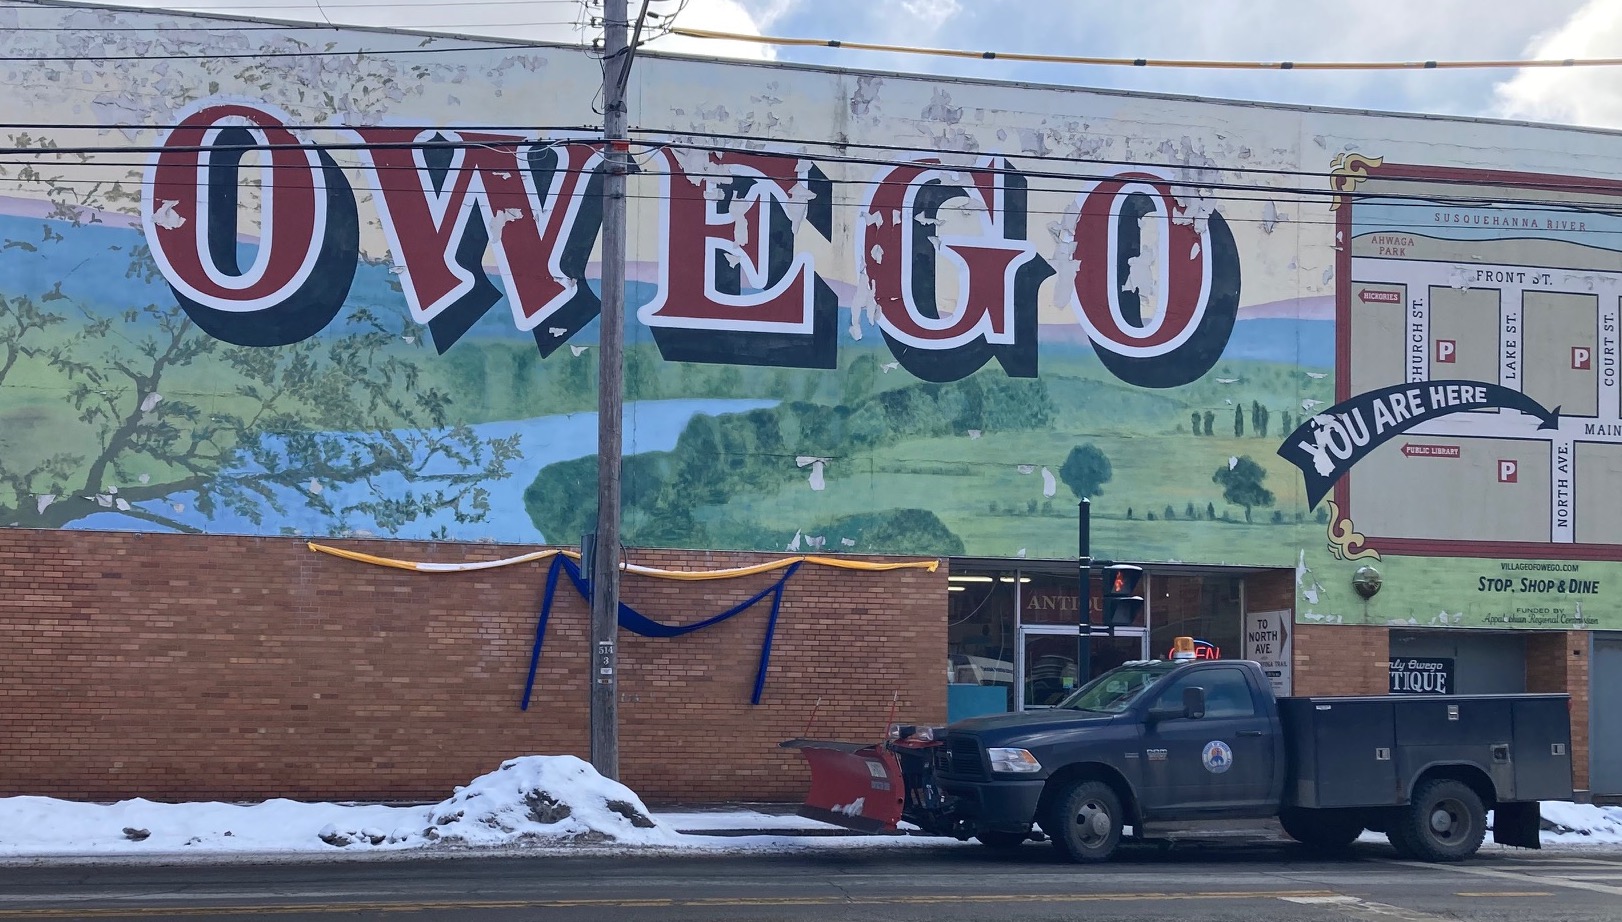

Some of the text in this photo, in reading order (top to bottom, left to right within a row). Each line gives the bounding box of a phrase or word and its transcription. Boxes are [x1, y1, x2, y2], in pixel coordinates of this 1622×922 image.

[1434, 212, 1587, 231] SUSQUEHANNA RIVER
[142, 98, 1240, 388] OWEGO
[1371, 235, 1415, 247] AHWAGA
[1379, 246, 1406, 257] PARK
[1476, 269, 1525, 284] FRONT
[1363, 292, 1398, 301] HICKORIES
[1412, 298, 1423, 319] ST.
[1439, 341, 1453, 361] P
[1505, 312, 1517, 379] LAKE ST.
[1604, 312, 1614, 387] COURT ST.
[1575, 349, 1589, 368] P
[1298, 385, 1487, 477] YOU ARE HERE
[1585, 423, 1622, 436] MAIN
[1406, 446, 1458, 455] PUBLIC LIBRARY
[1501, 462, 1516, 480] P
[1557, 442, 1568, 527] NORTH AVE.
[1501, 563, 1579, 572] VILLAGEOFOWEGO.COM
[1520, 577, 1555, 593] SHOP
[1557, 582, 1566, 594] &
[1569, 579, 1600, 594] DINE
[1257, 619, 1268, 629] TO
[1481, 612, 1527, 625] Appalchian
[1248, 631, 1278, 642] NORTH
[598, 646, 613, 655] 514
[1255, 644, 1273, 654] AVE.
[603, 657, 609, 665] 3
[1408, 660, 1444, 671] Owego
